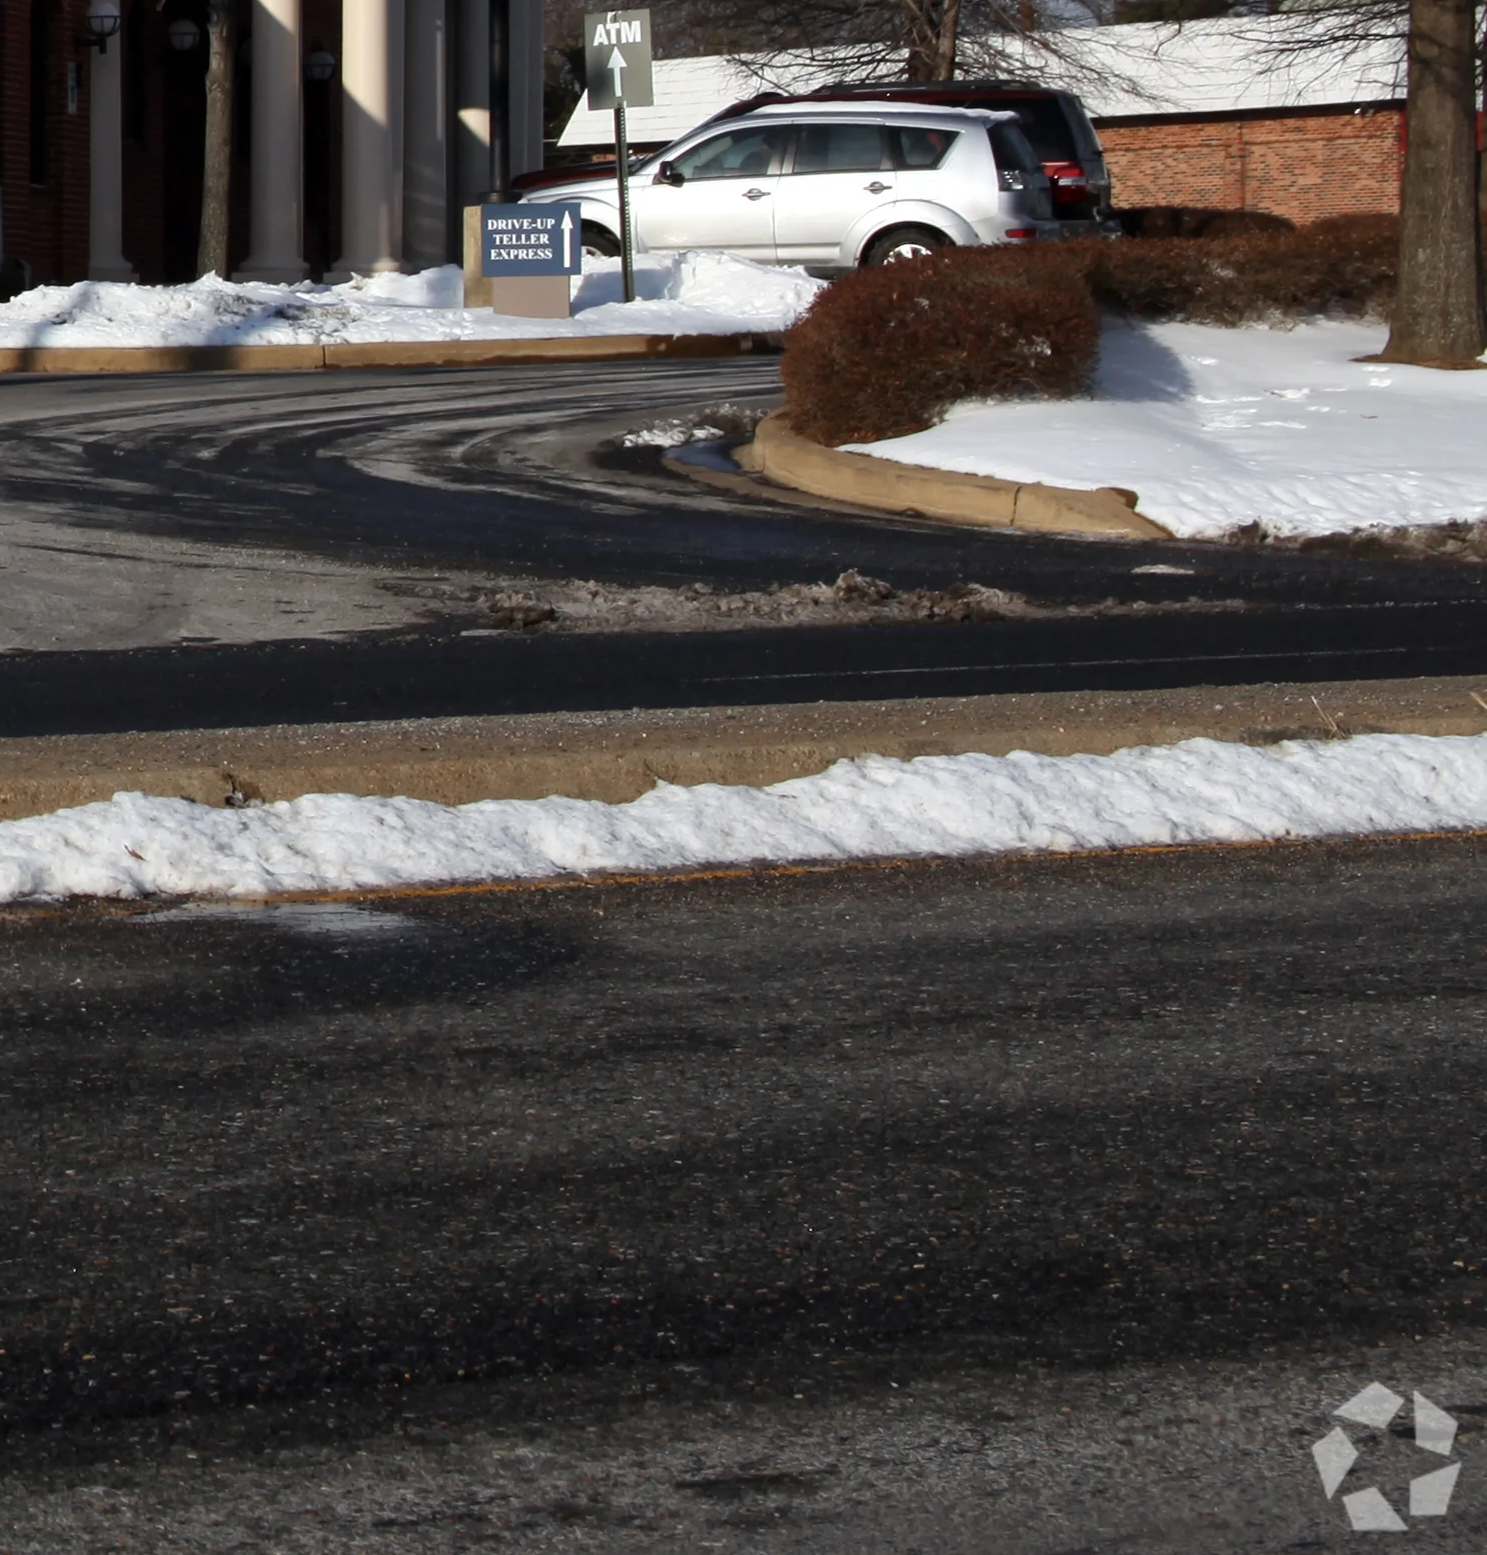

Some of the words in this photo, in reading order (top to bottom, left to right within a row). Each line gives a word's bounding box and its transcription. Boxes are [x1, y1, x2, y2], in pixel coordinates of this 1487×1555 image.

[592, 20, 642, 47] ATM
[487, 218, 556, 231] DRIVE-UP
[493, 233, 550, 245] TELLER
[490, 248, 553, 261] EXPRESS
